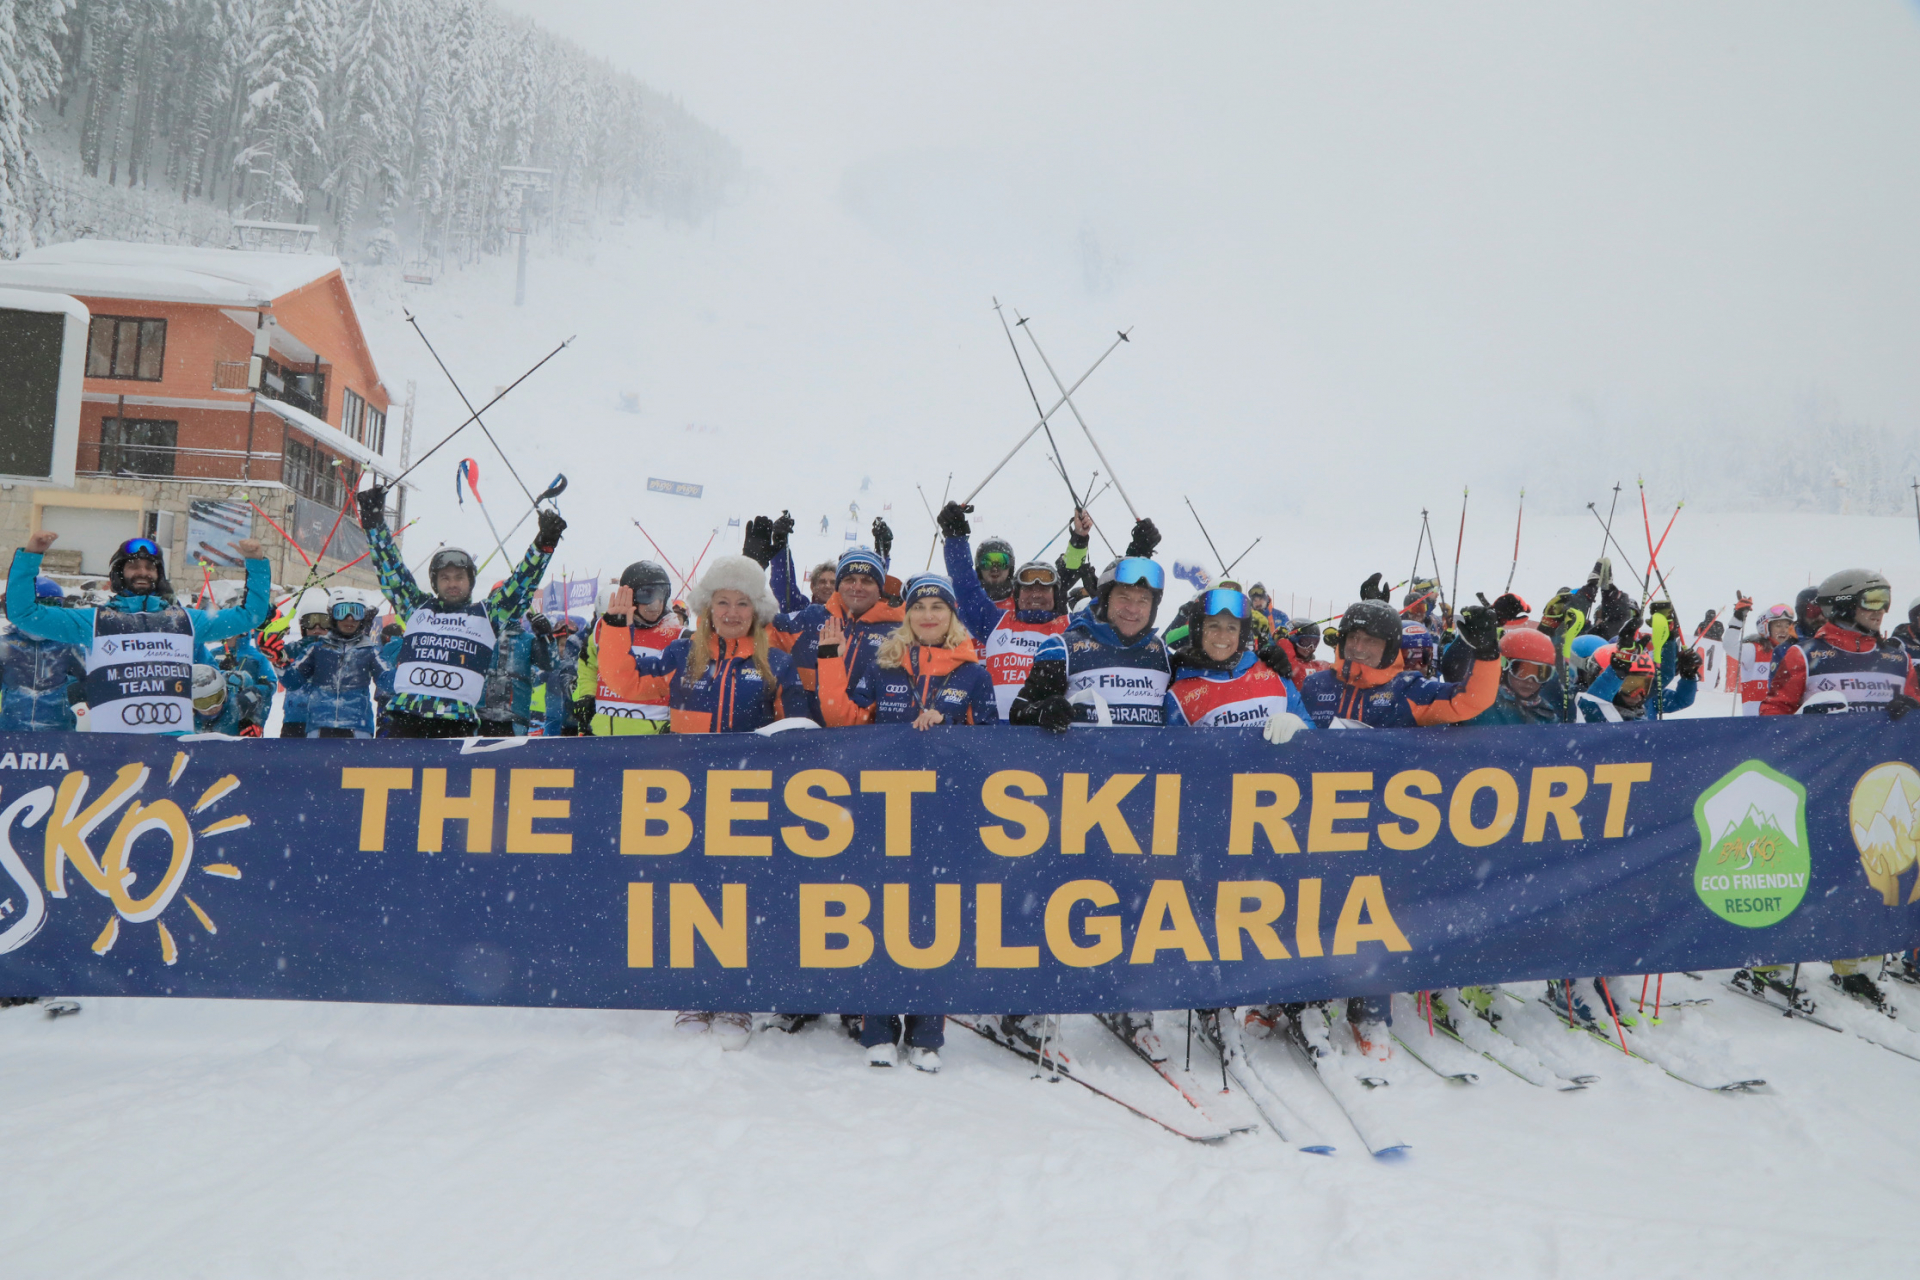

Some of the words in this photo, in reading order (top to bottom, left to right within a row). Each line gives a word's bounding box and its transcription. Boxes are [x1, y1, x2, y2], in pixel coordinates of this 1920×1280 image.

[121, 639, 173, 651] Fibank
[420, 635, 477, 655] GIRARDELLI
[415, 648, 449, 661] TEAM
[460, 654, 465, 665] 1
[993, 657, 1001, 668] D.
[1004, 655, 1034, 667] COMP
[107, 669, 121, 681] M.
[1002, 670, 1030, 680] TEA
[1099, 674, 1153, 690] Fibank
[119, 680, 165, 694] TEAM
[175, 681, 183, 693] 6
[600, 685, 624, 698] TEA
[1111, 707, 1162, 723] GIRARDEL
[1214, 704, 1269, 726] Fibank
[342, 768, 574, 854] THE
[621, 769, 936, 857] BEST
[980, 770, 1181, 856] SKI
[1229, 763, 1651, 854] RESORT
[1717, 835, 1776, 870] BANSKO
[1701, 876, 1730, 891] ECO
[1734, 873, 1805, 890] FRIENDLY
[1725, 897, 1782, 913] RESORT
[628, 883, 747, 967] IN
[800, 876, 1411, 968] BULGARIA
